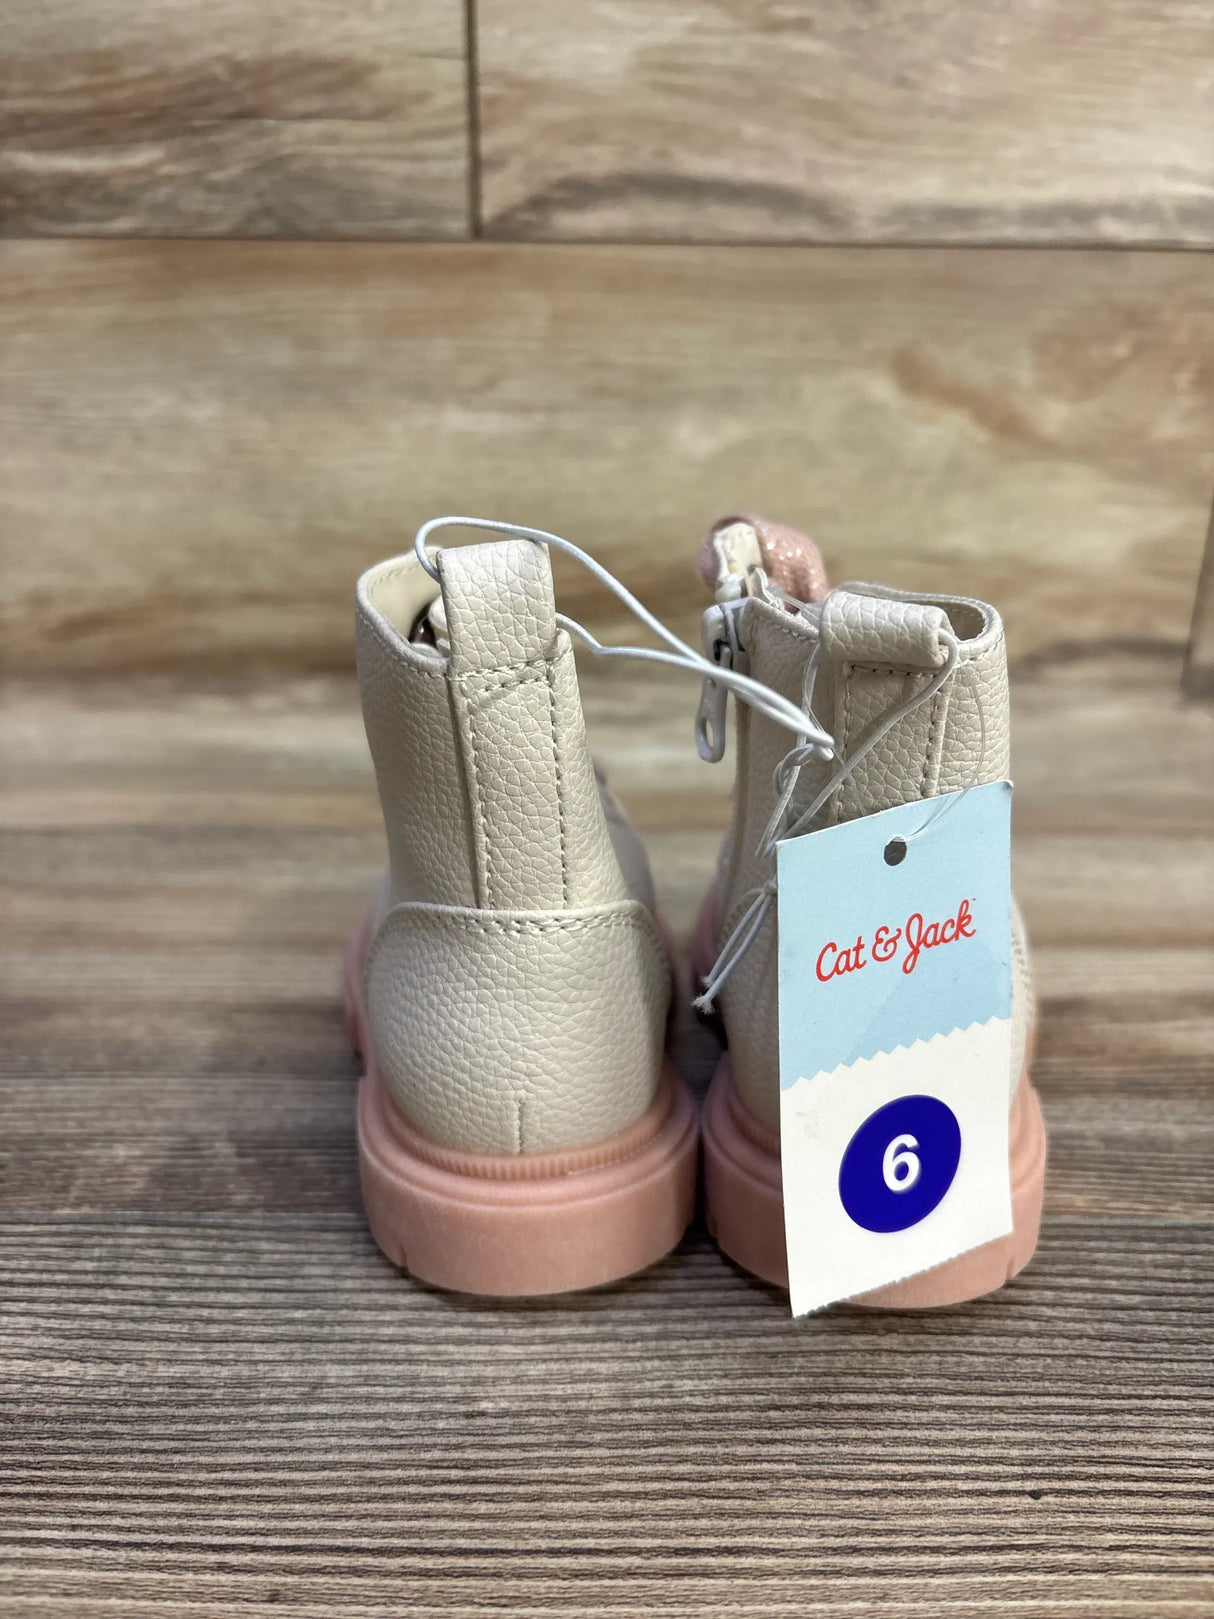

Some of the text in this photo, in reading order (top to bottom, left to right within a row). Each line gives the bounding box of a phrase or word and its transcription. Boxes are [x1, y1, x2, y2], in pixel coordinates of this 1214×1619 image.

[816, 899, 976, 982] Cat & Jack
[882, 1134, 920, 1192] 6
